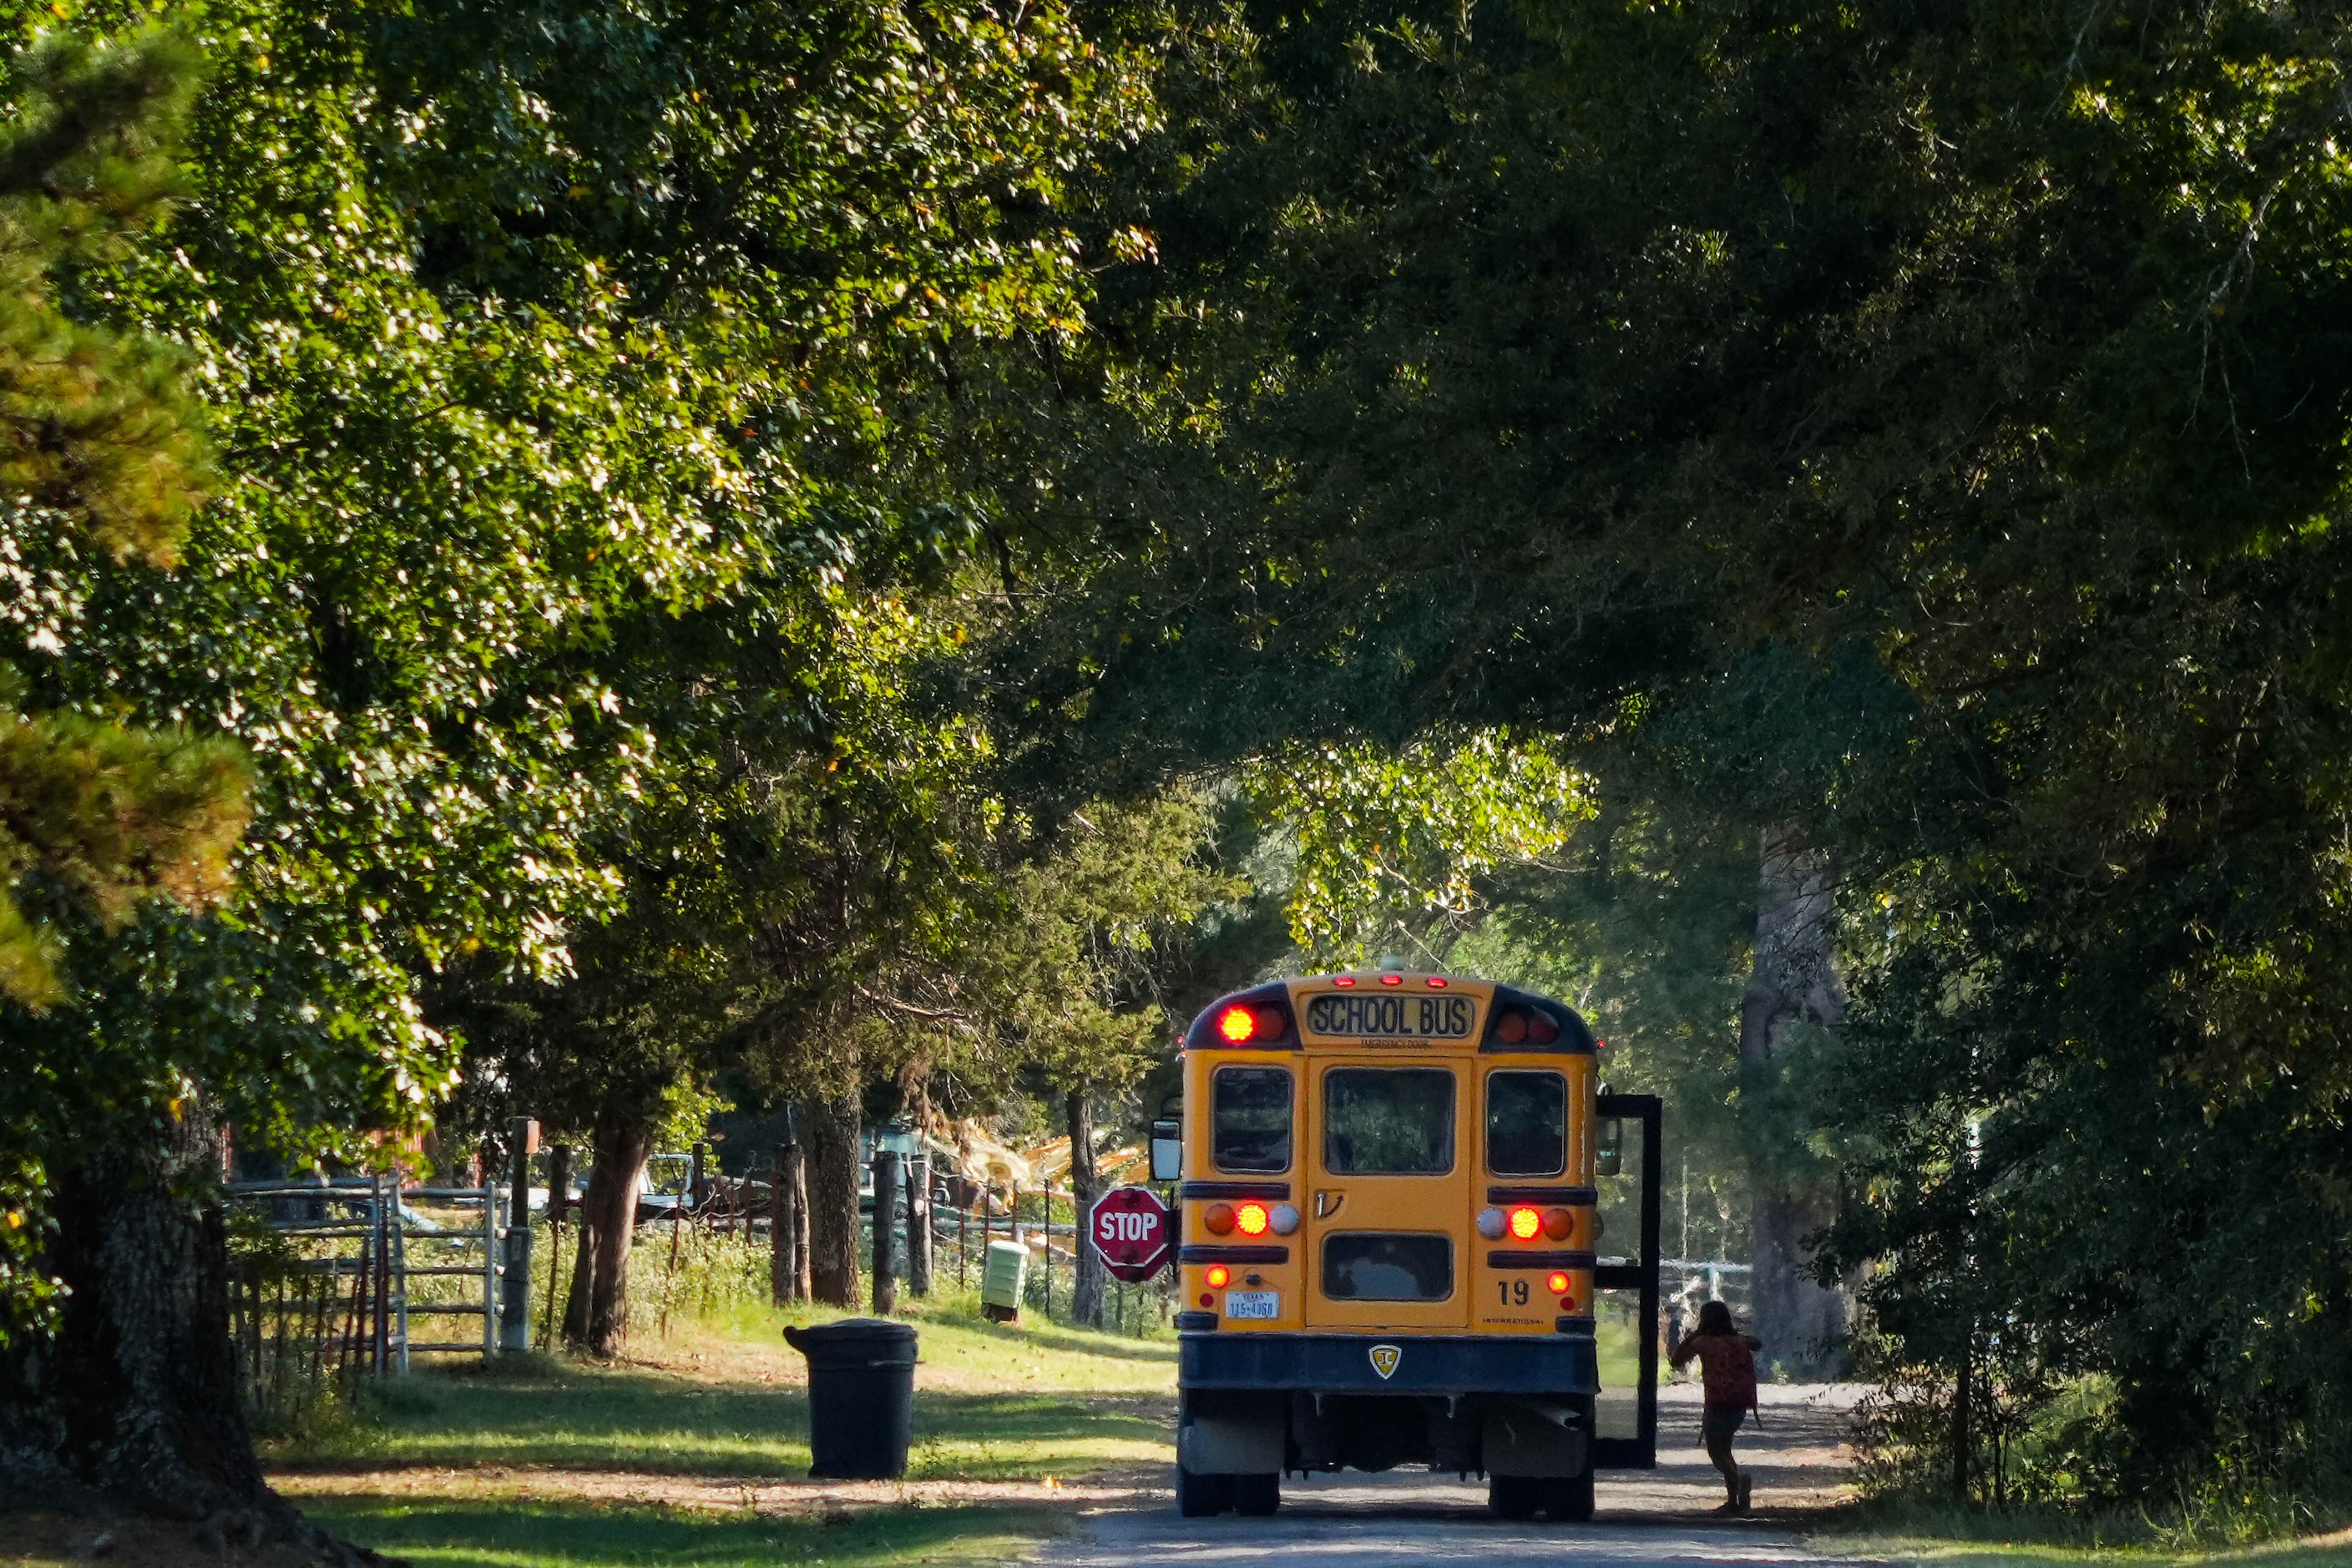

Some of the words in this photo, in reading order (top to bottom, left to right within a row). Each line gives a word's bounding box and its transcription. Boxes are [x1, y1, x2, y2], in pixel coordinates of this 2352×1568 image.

[1314, 994, 1413, 1034] SCHOOL
[1420, 997, 1467, 1035] BUS
[1100, 1211, 1158, 1242] STOP
[1498, 1278, 1530, 1306] 19
